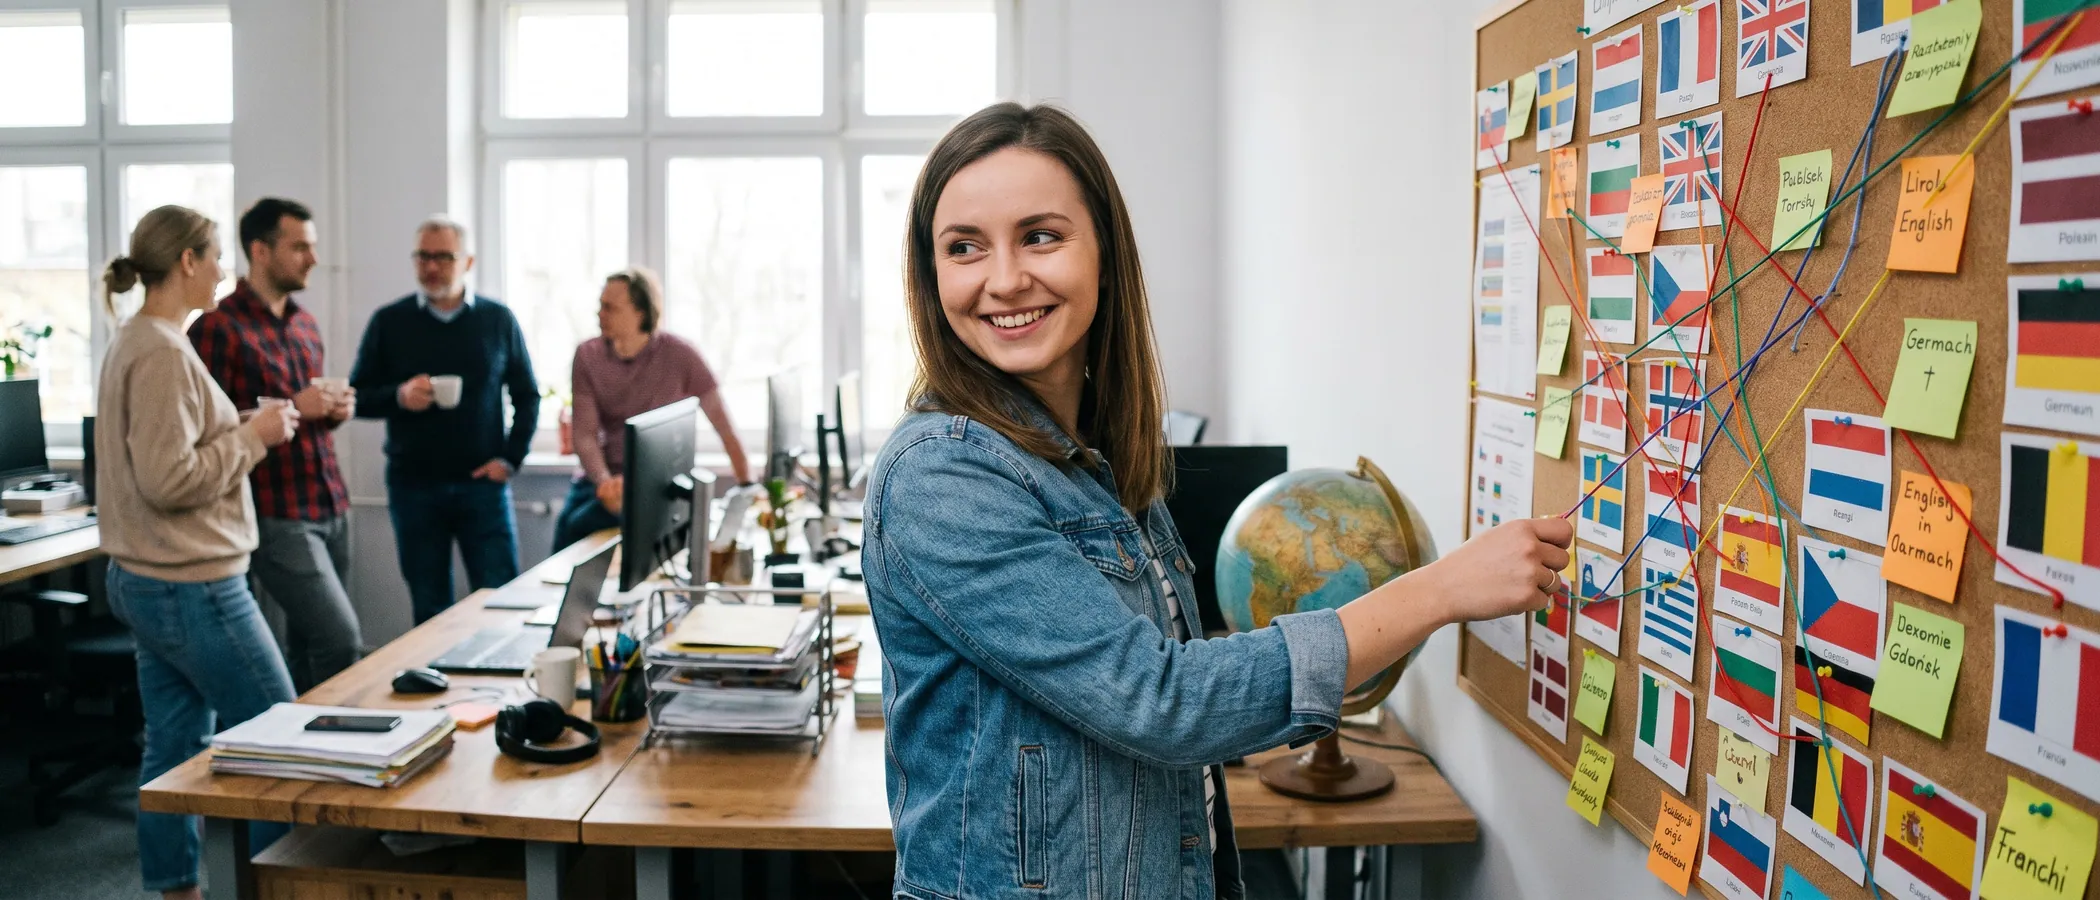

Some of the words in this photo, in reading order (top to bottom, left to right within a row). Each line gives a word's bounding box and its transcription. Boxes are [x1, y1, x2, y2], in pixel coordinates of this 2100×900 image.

[1899, 208, 1953, 242] English
[1906, 328, 1972, 354] Germach
[1918, 516, 1931, 534] in
[1999, 826, 2069, 894] Franchi
